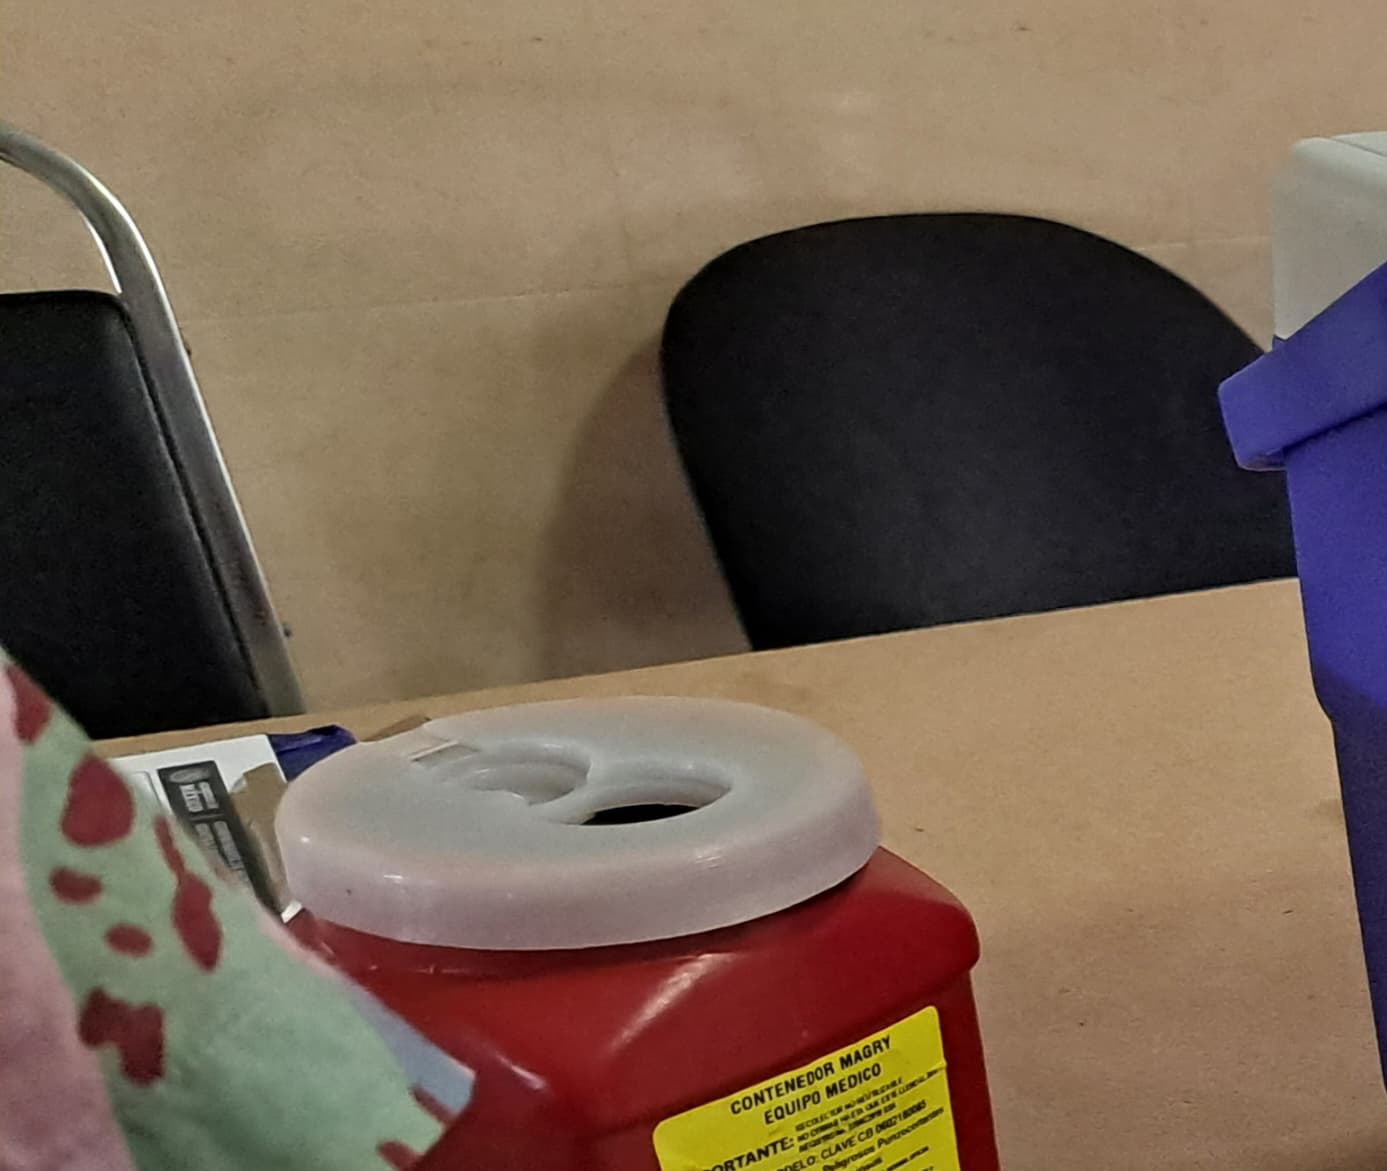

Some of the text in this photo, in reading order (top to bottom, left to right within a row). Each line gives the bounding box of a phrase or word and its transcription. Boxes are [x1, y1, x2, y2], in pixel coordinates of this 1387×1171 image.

[730, 1035, 892, 1115] CONTENEDOR MAGRY
[763, 1091, 822, 1126] EQUIPO
[825, 1062, 882, 1099] MEDICO
[820, 1137, 857, 1160] CLAVE
